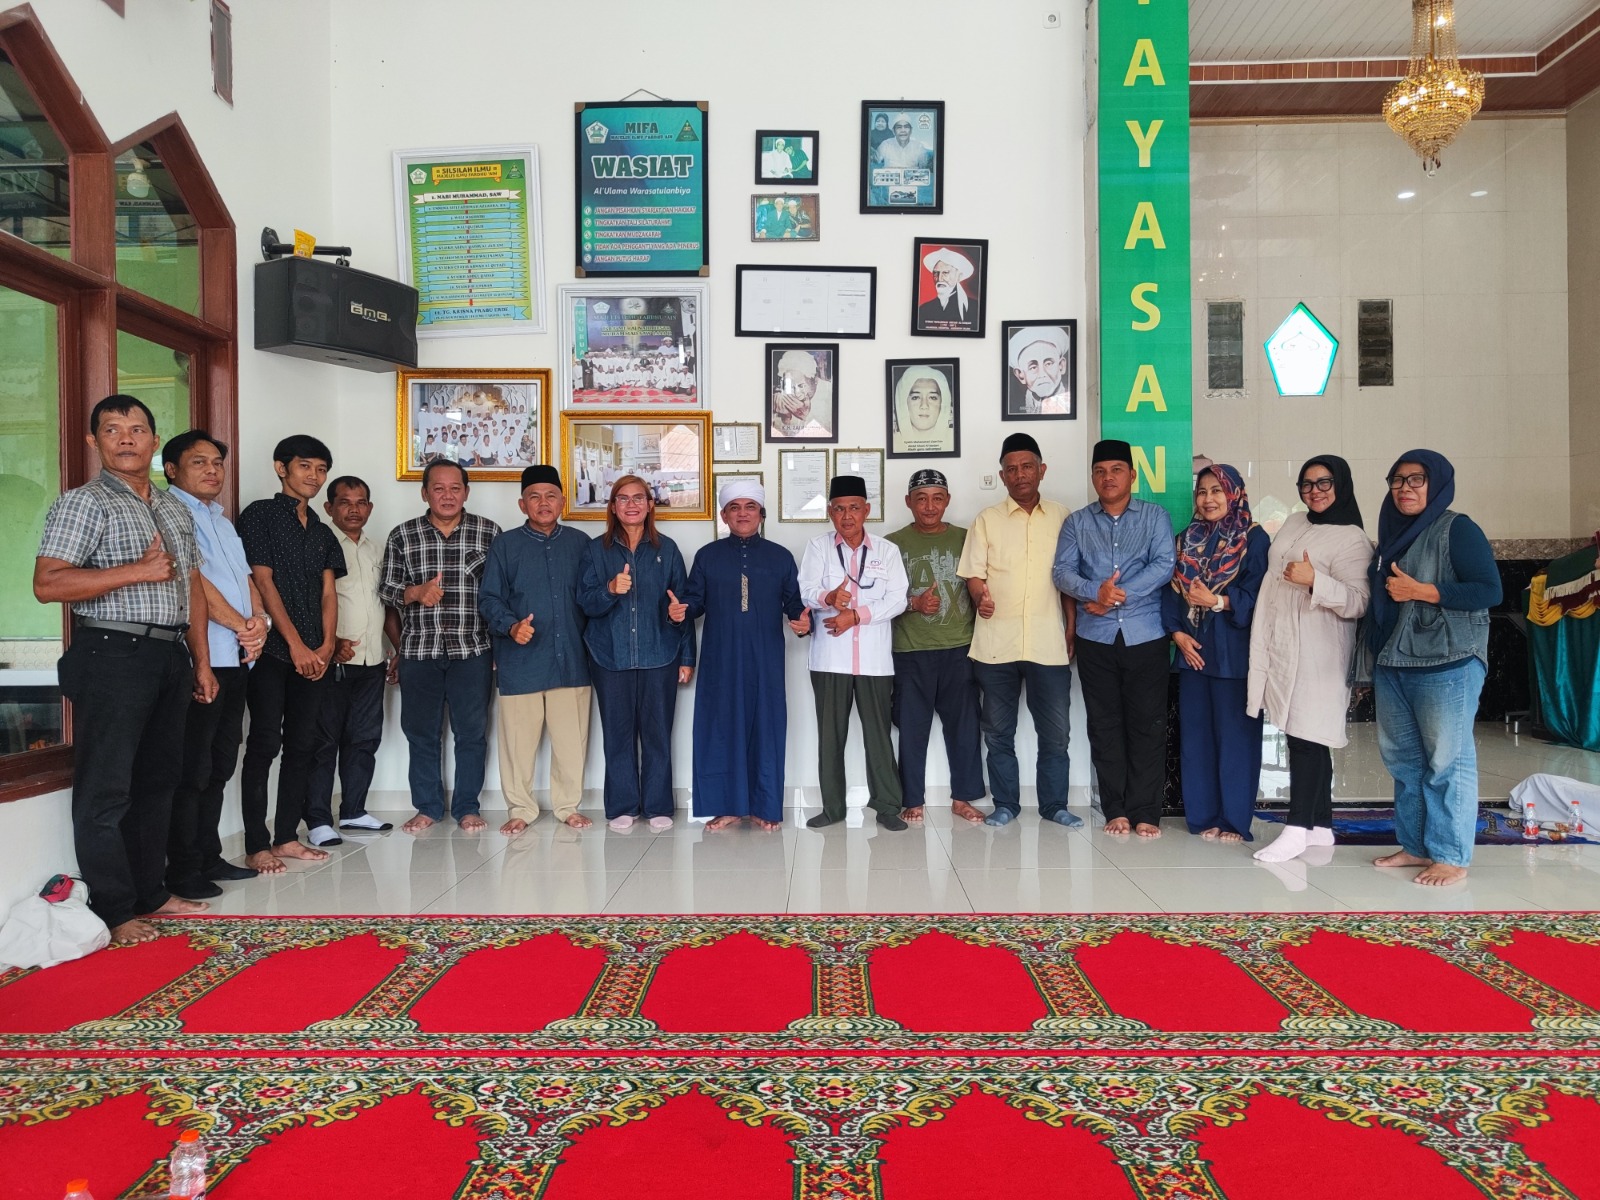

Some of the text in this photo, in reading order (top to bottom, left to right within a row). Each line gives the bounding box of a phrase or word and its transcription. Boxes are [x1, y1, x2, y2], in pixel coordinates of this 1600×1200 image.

[624, 122, 659, 134] MIFA
[591, 154, 694, 179] WASIAT
[629, 186, 691, 196] Warasatulanbiya
[1123, 0, 1168, 494] AYASAN
